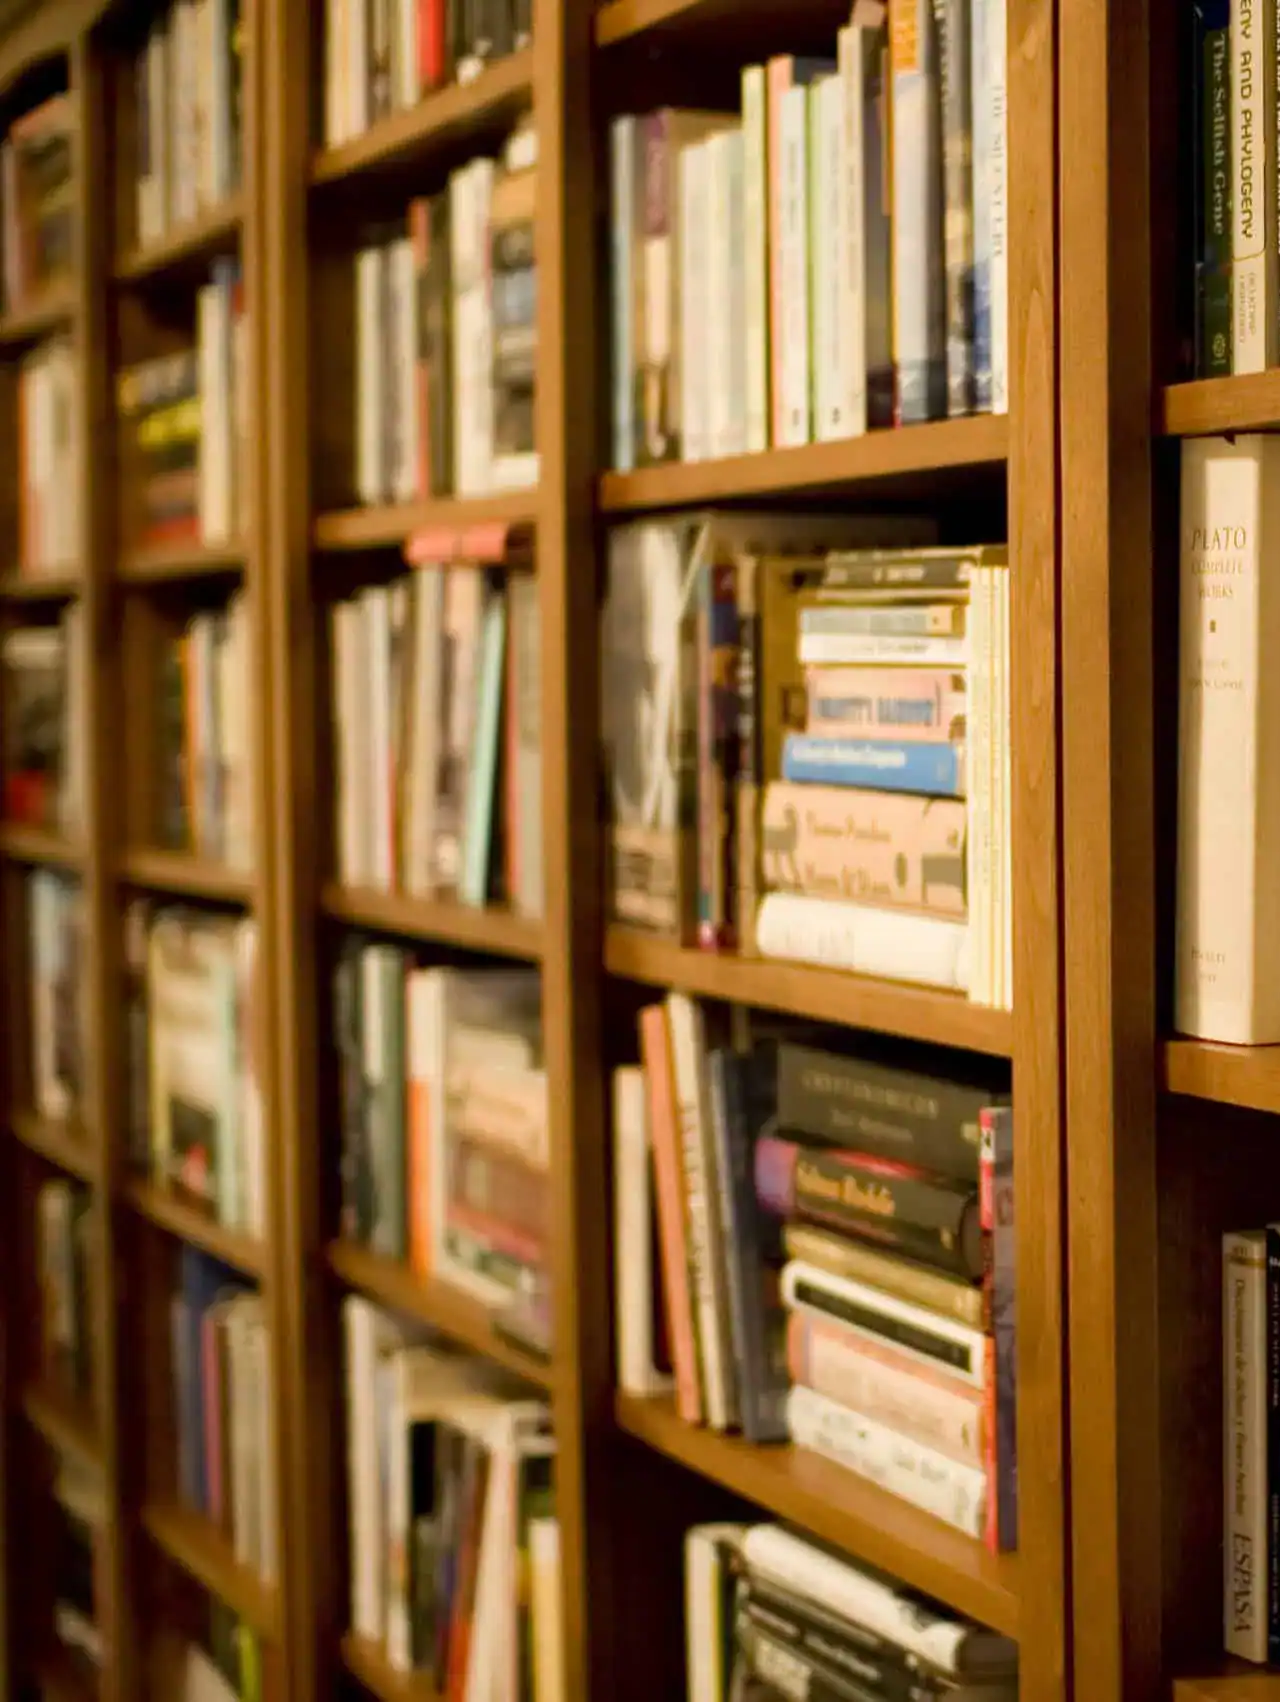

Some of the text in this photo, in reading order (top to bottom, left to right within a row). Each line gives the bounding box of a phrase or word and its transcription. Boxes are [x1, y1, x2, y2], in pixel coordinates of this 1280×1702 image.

[1240, 53, 1253, 102] AND
[1212, 36, 1226, 236] The Selfish Gene
[1240, 110, 1253, 239] PHYLOGENY
[1191, 526, 1246, 551] PLATO
[1233, 1532, 1254, 1634] ESPASA
